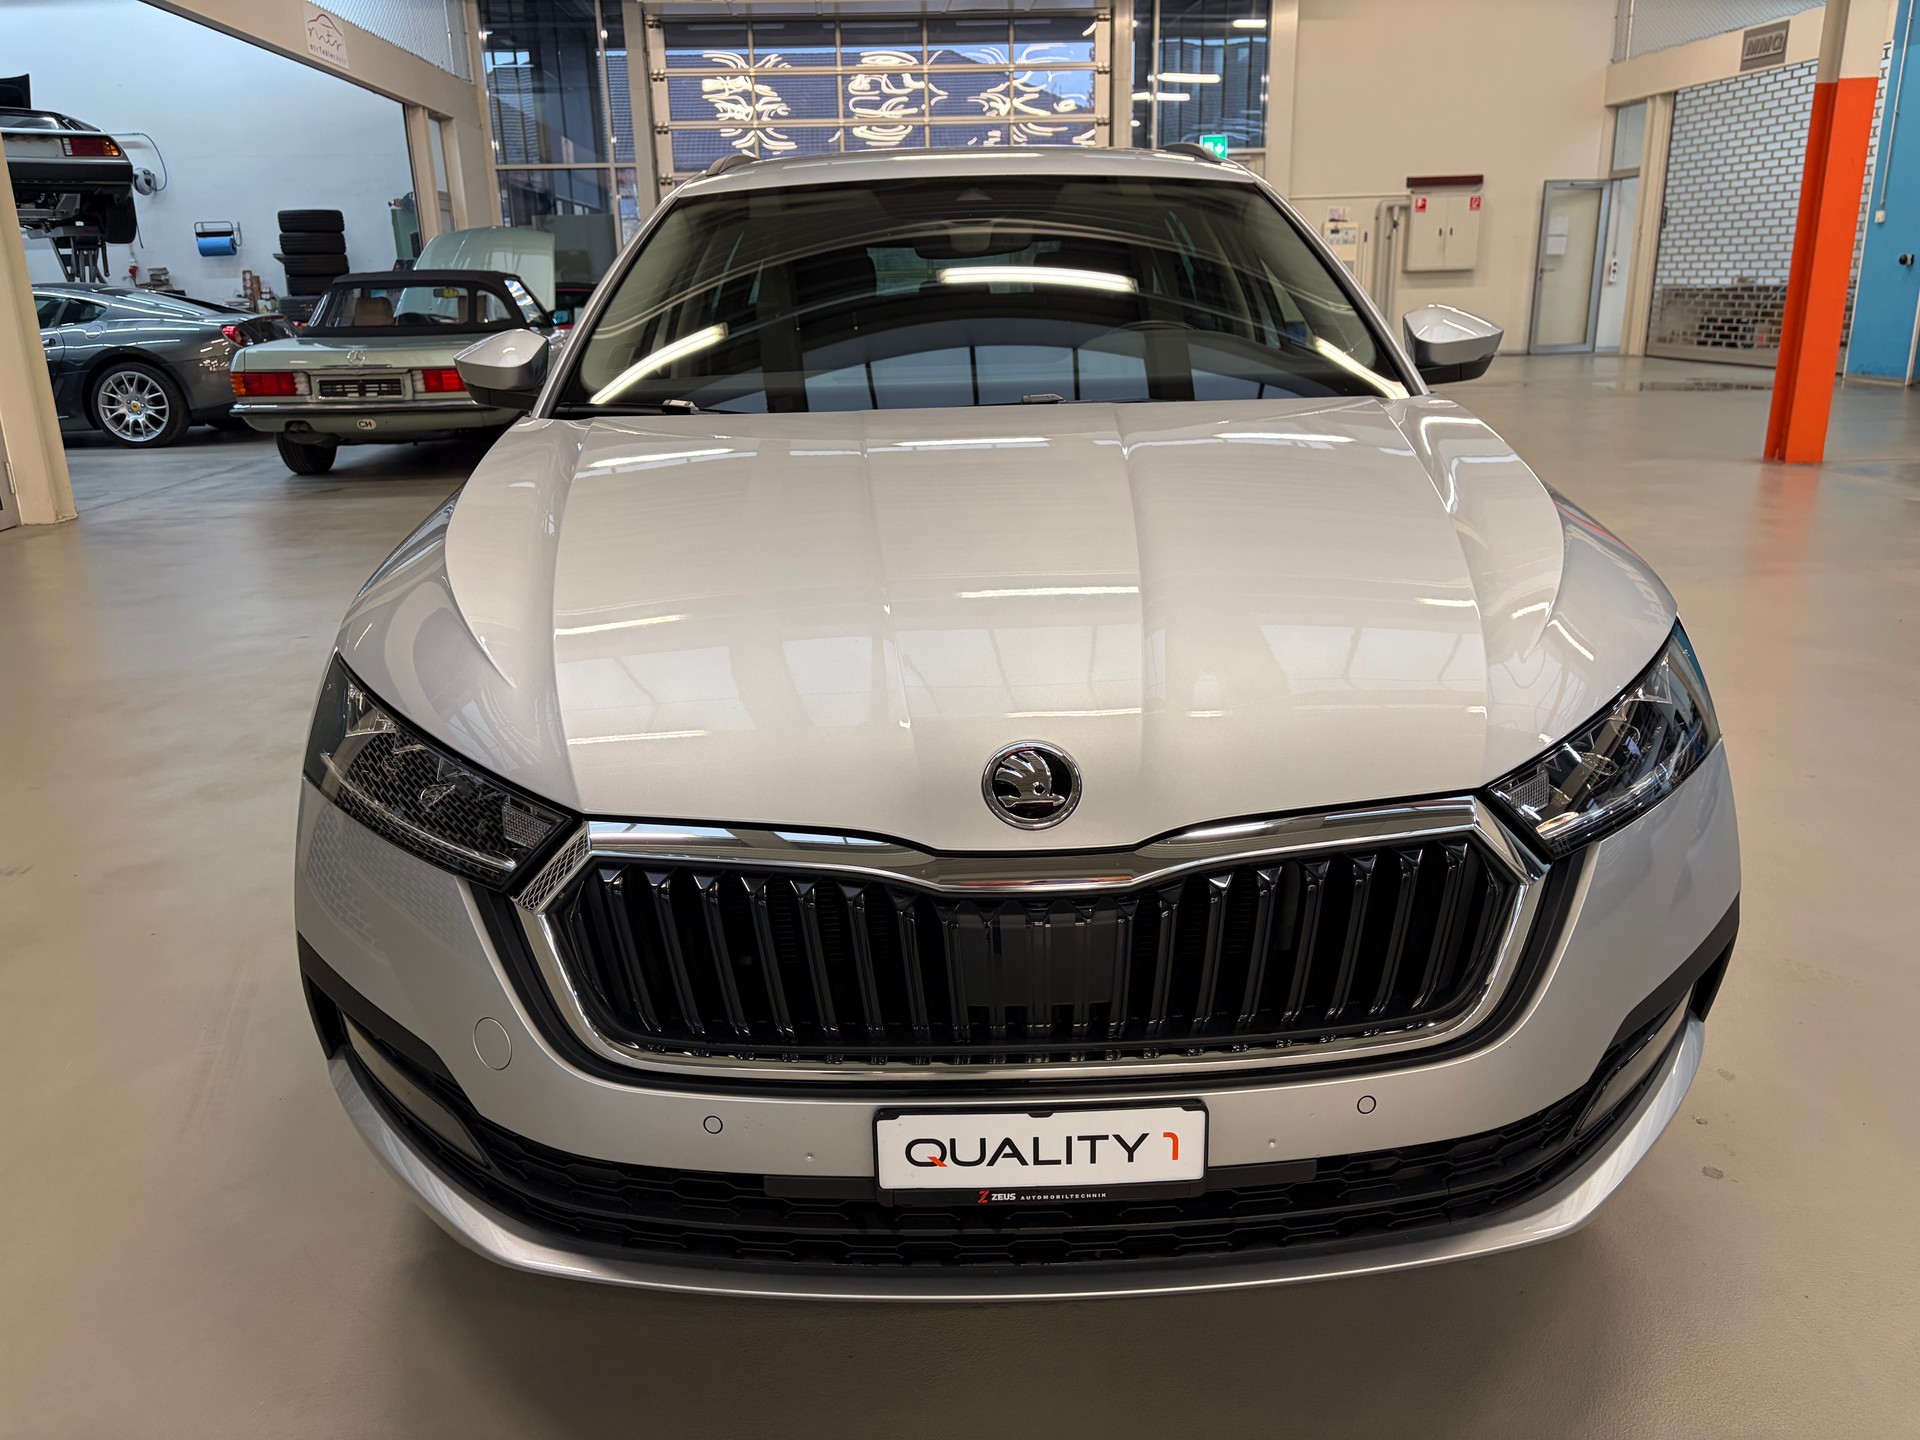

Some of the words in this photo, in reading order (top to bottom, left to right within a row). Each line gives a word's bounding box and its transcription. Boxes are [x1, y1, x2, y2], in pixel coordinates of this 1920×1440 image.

[358, 420, 373, 428] CH
[905, 1132, 1150, 1167] QUALITY
[991, 1193, 1016, 1201] ZEUS
[1020, 1192, 1107, 1201] AUTOMOBILTECHNIK
